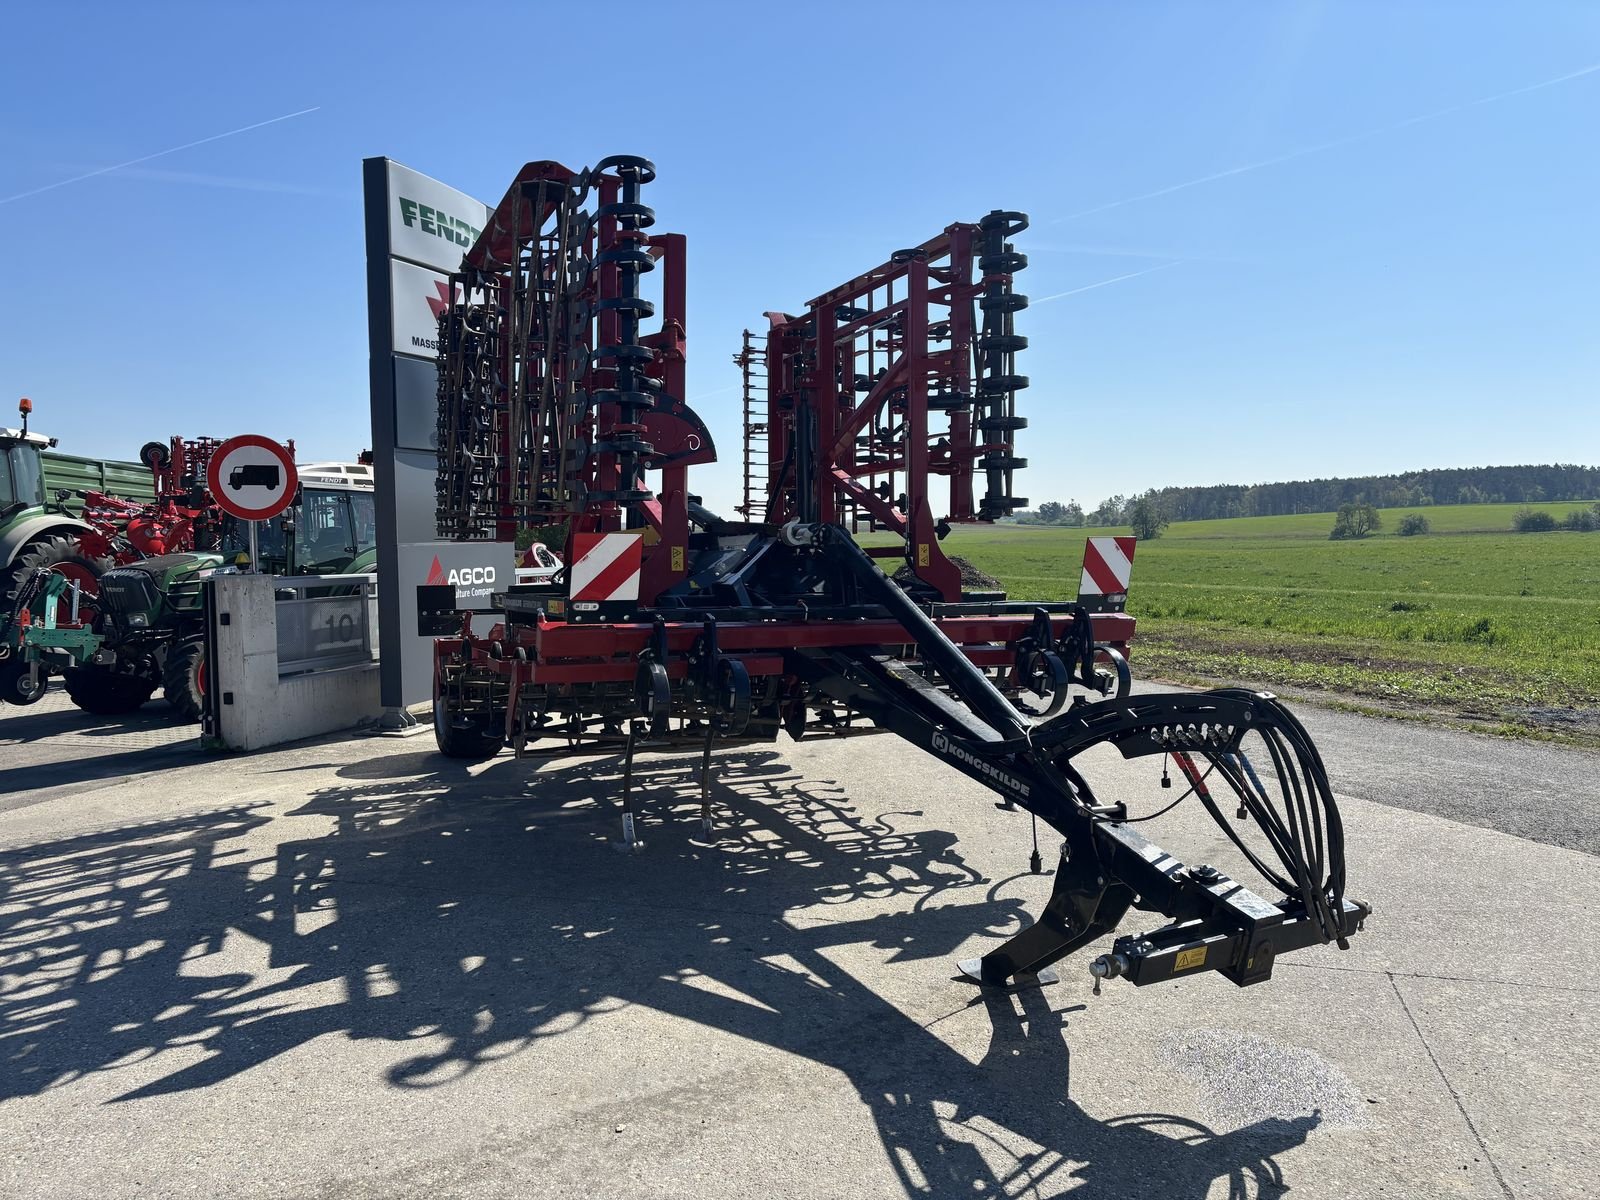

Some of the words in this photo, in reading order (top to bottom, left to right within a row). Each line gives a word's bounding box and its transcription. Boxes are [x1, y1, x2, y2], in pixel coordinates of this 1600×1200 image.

[448, 566, 496, 586] AGCO
[325, 614, 353, 643] 10
[949, 743, 1030, 797] KONGSKILDE
